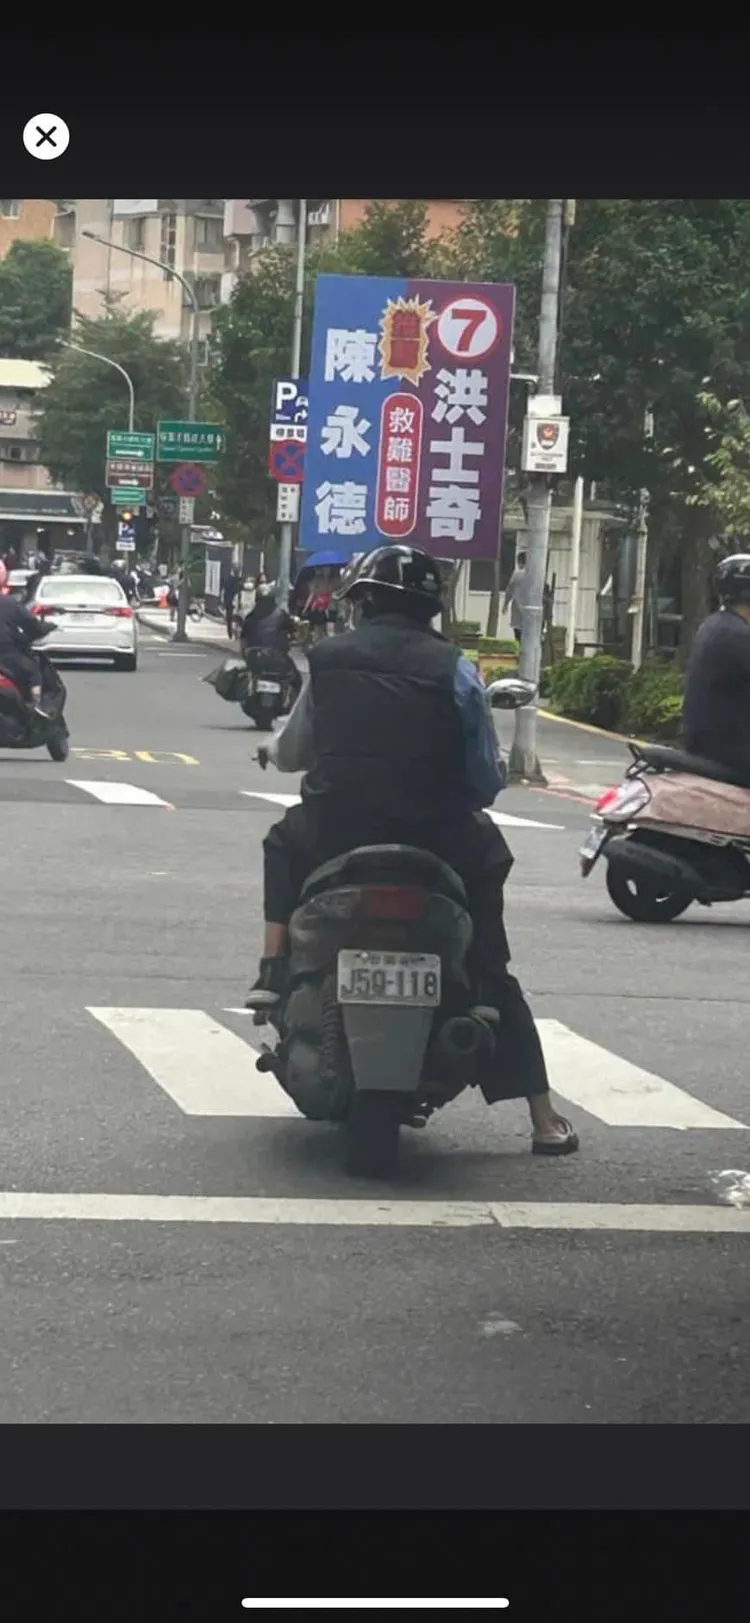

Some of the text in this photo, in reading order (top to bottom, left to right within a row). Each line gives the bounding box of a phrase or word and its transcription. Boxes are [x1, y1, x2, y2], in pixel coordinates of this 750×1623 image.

[452, 309, 488, 353] 7
[276, 381, 299, 410] P
[314, 328, 378, 536] 陳永德
[383, 406, 415, 523] 救難醫師
[426, 367, 489, 542] 洪士奇
